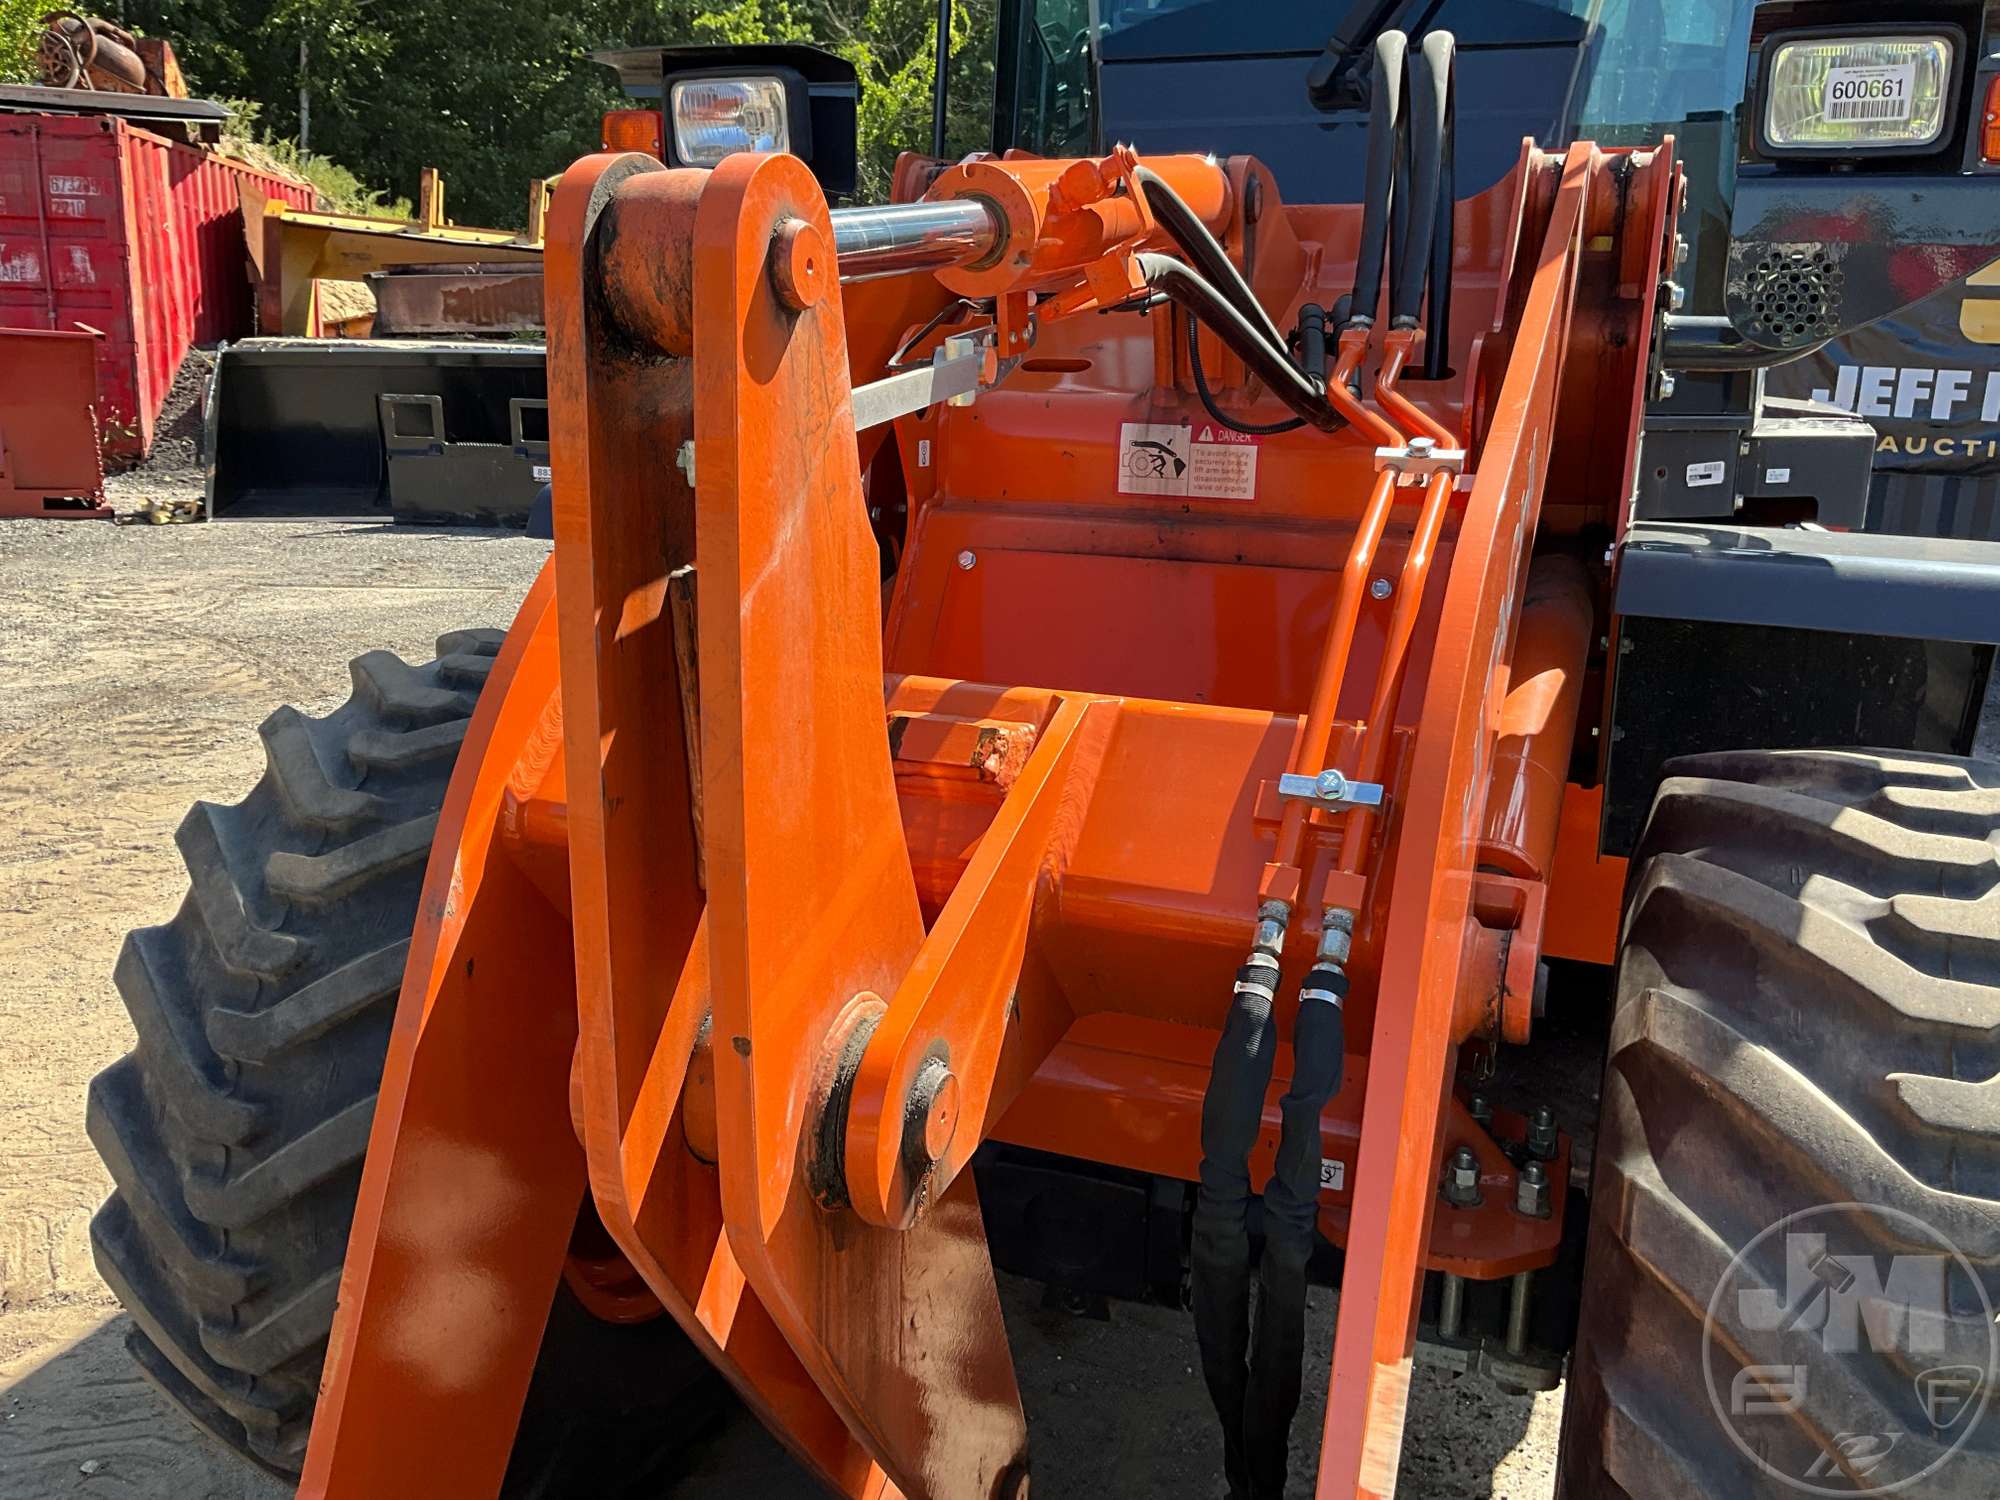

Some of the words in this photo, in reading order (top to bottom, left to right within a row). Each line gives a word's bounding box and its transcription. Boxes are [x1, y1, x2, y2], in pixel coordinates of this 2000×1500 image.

[1832, 78, 1903, 99] 600661
[1812, 365, 1973, 420] JEFF
[1218, 430, 1251, 442] DANGER
[1876, 435, 1996, 458] AUCTI
